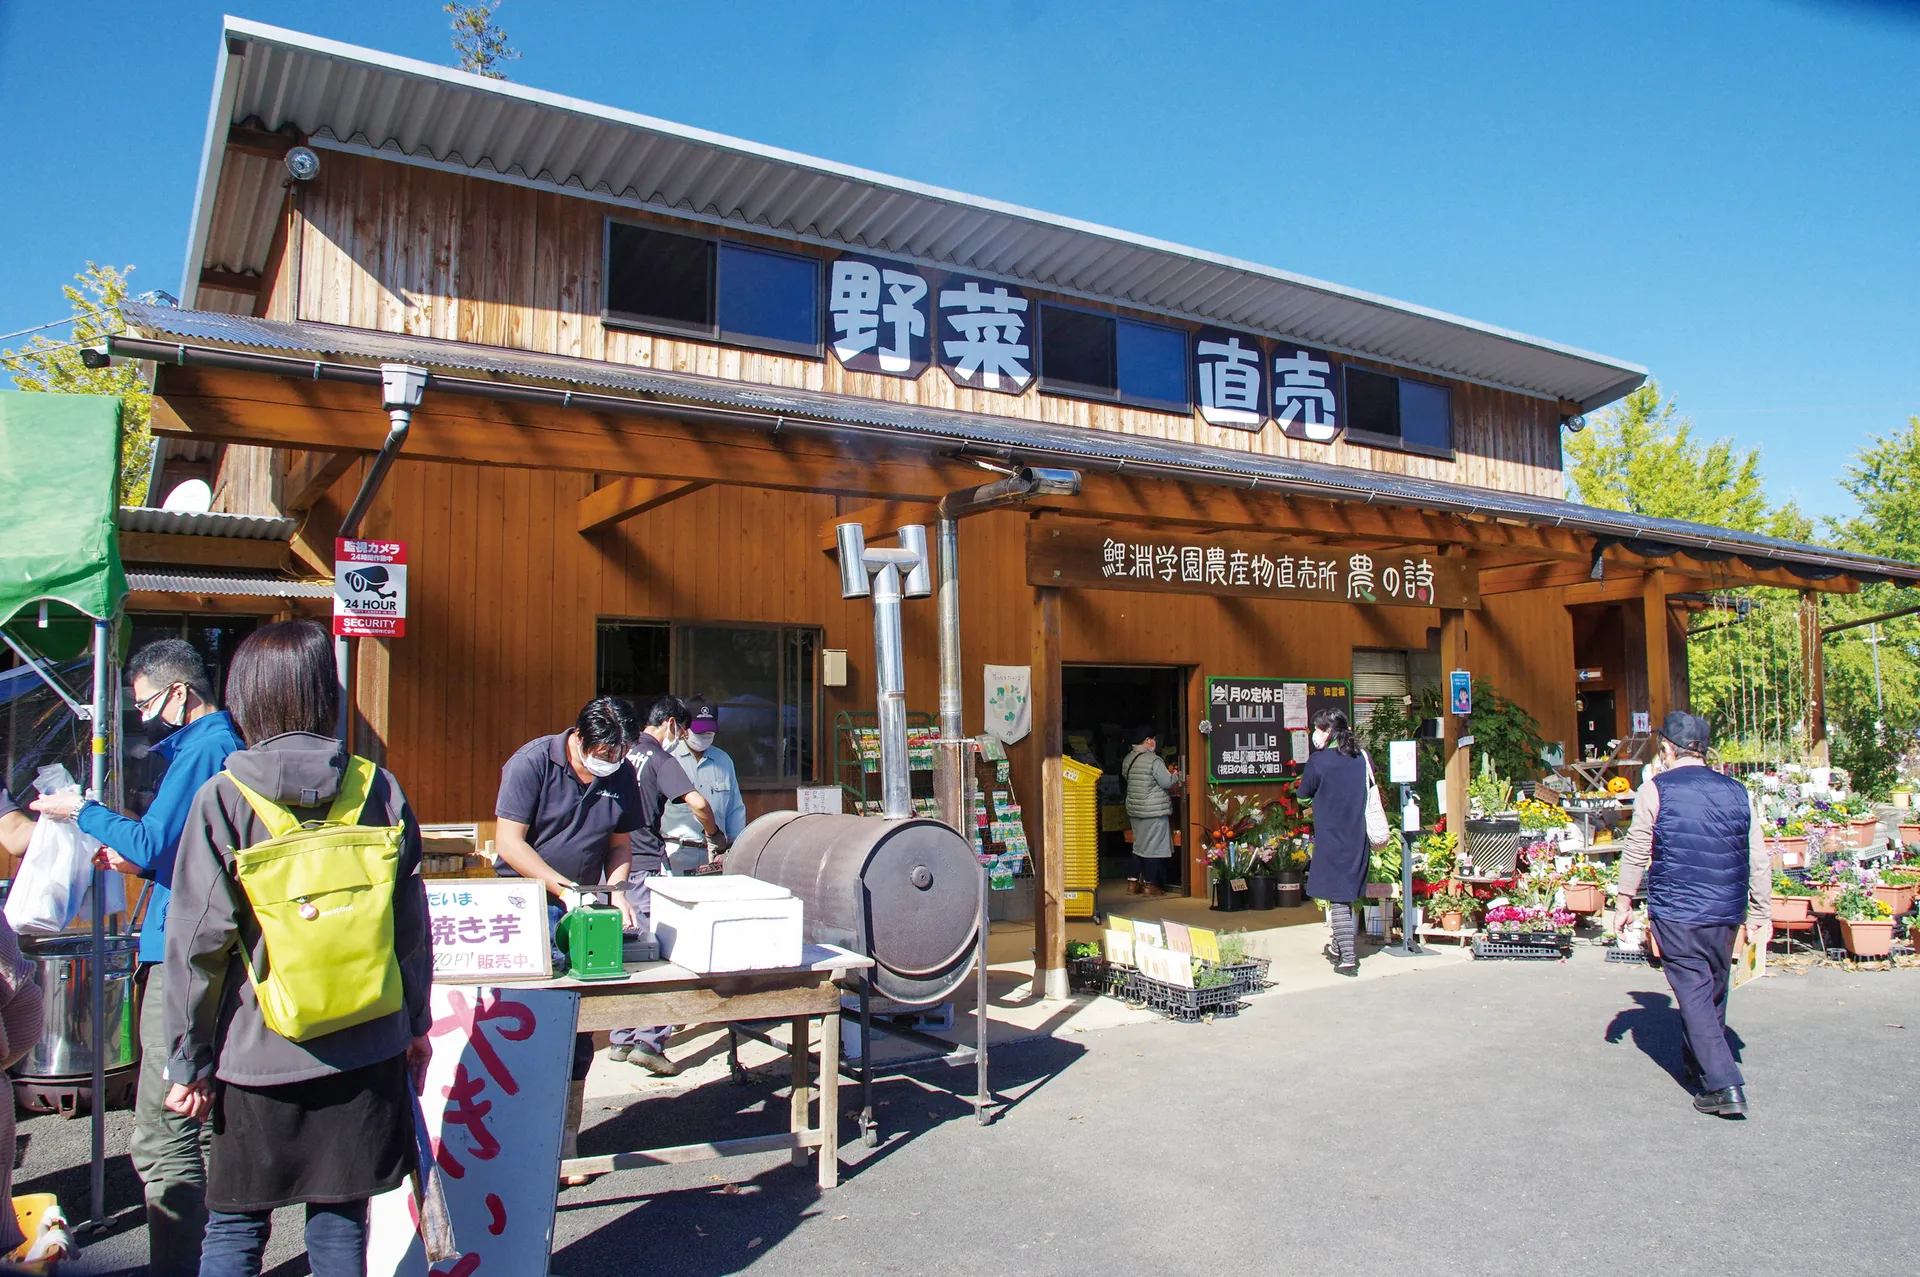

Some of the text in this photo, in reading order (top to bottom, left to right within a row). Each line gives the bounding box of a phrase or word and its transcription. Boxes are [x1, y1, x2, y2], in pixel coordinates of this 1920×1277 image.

[830, 261, 1336, 440] 野菜 直売
[343, 540, 400, 555] 監視カメラ
[1102, 538, 1435, 605] 鯉淵学園農産物直売所 農の詩
[344, 599, 397, 611] 24 HOUR
[343, 618, 397, 628] SECURITY
[1213, 685, 1283, 703] 今月の定休日
[1268, 735, 1277, 747] 日
[431, 914, 521, 946] 焼き芋
